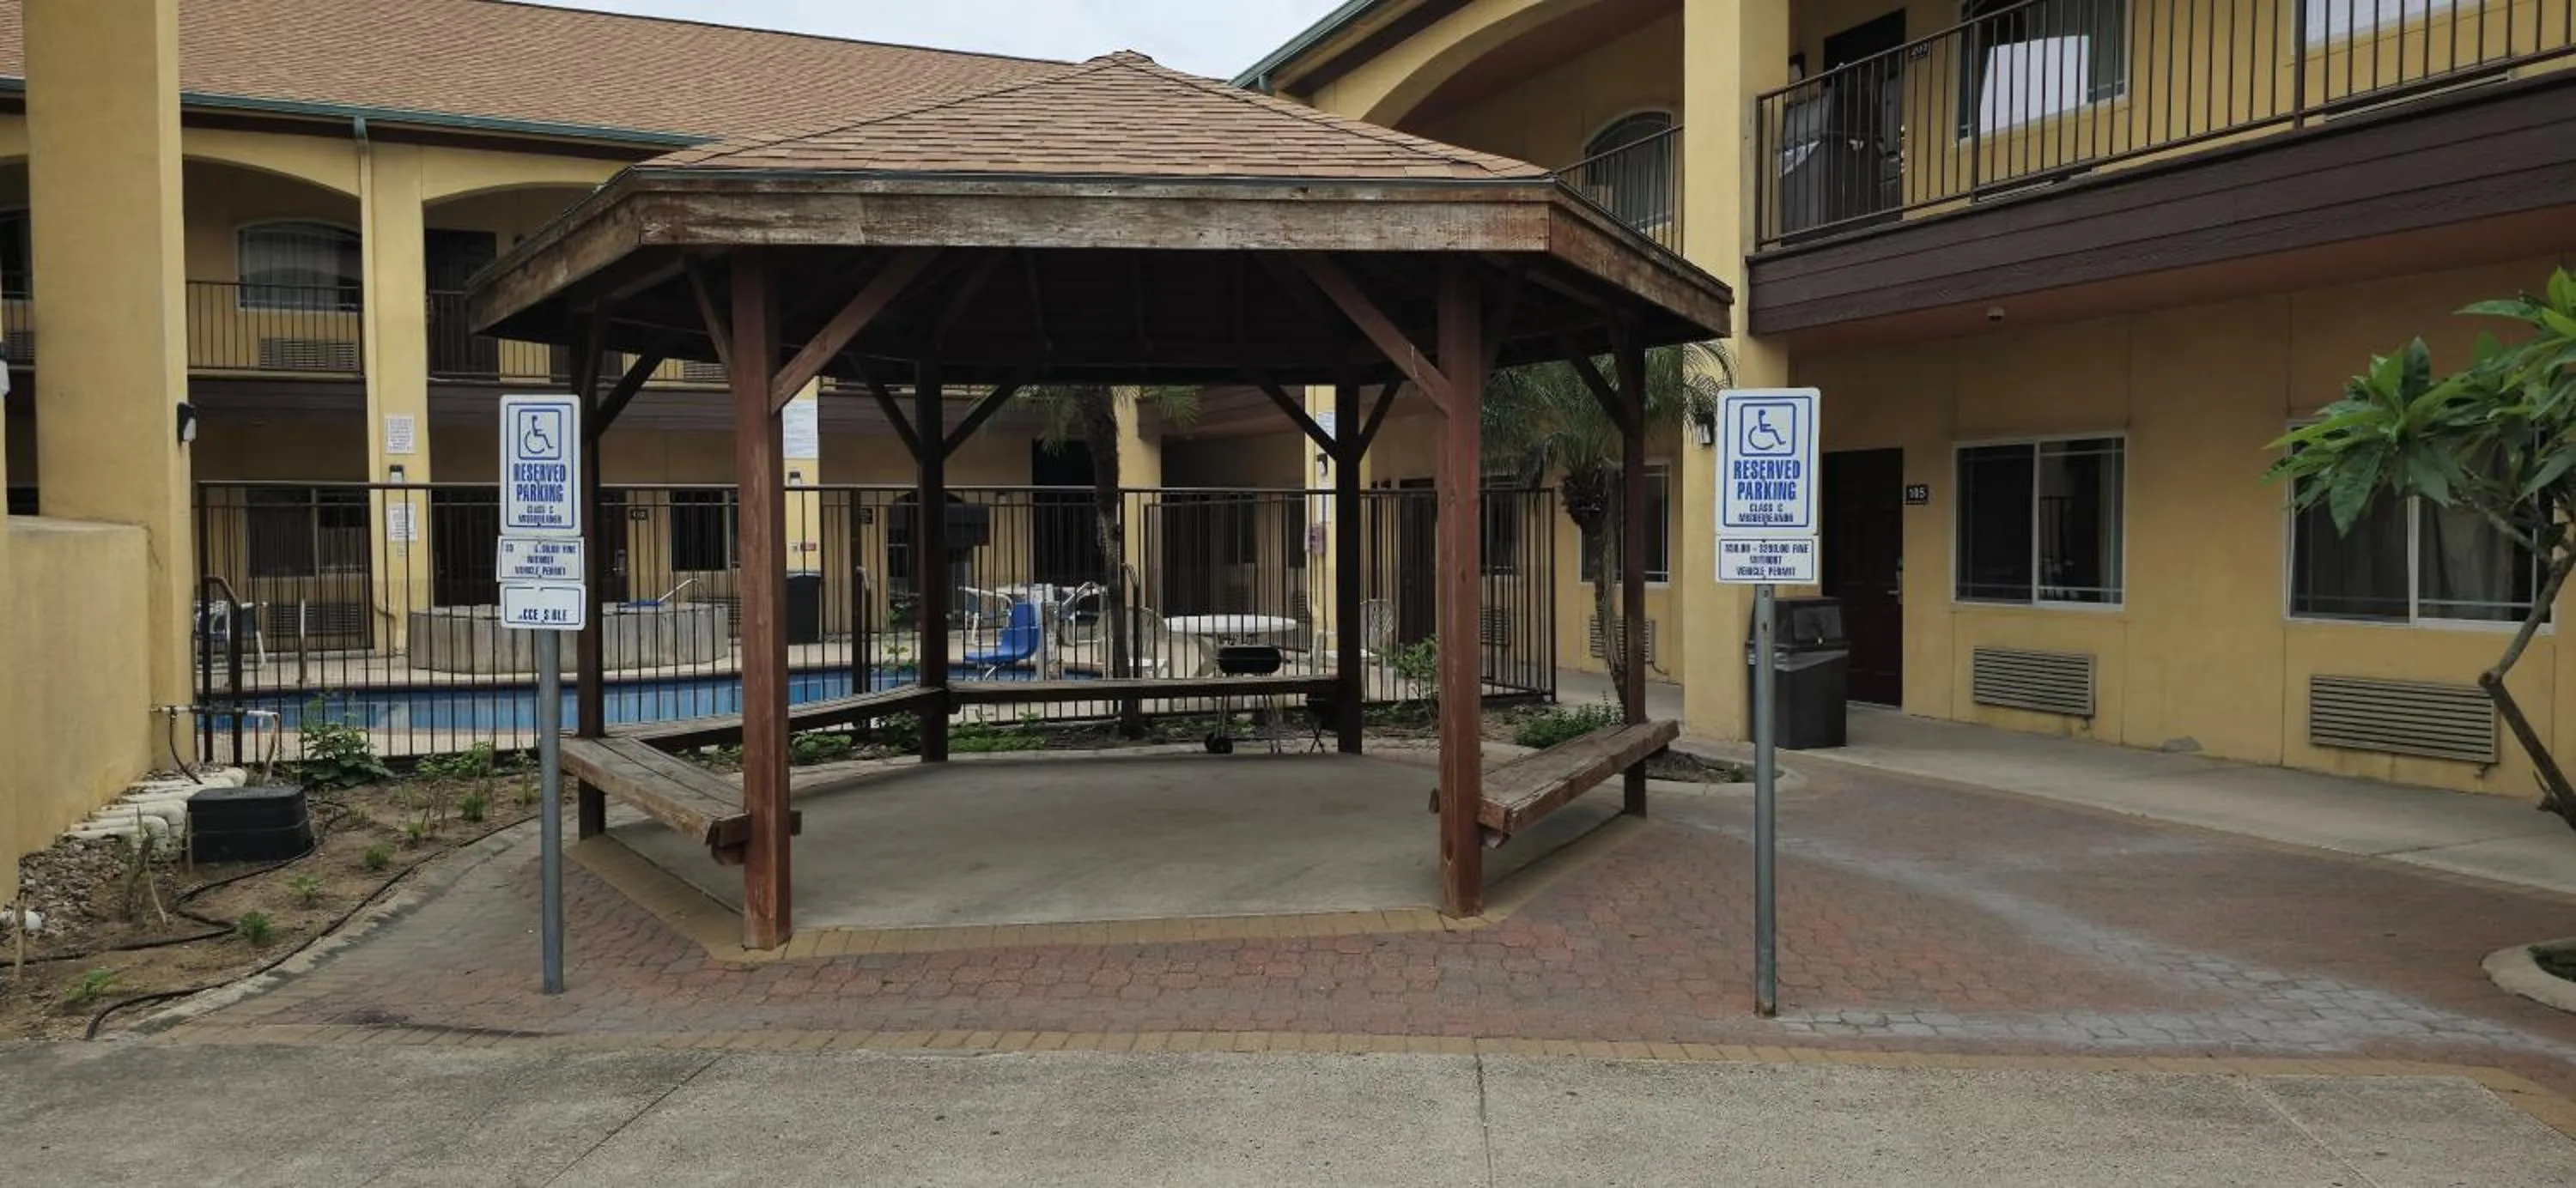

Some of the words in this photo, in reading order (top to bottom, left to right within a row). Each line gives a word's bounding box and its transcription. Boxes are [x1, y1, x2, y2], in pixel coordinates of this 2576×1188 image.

[513, 463, 567, 482] RESERVED
[1734, 459, 1801, 480] RESERVED
[516, 483, 564, 502] PARKING
[1737, 481, 1796, 500] PARKING
[1749, 503, 1773, 512] CLASS
[1777, 503, 1783, 512] C
[1792, 543, 1809, 554] FINE
